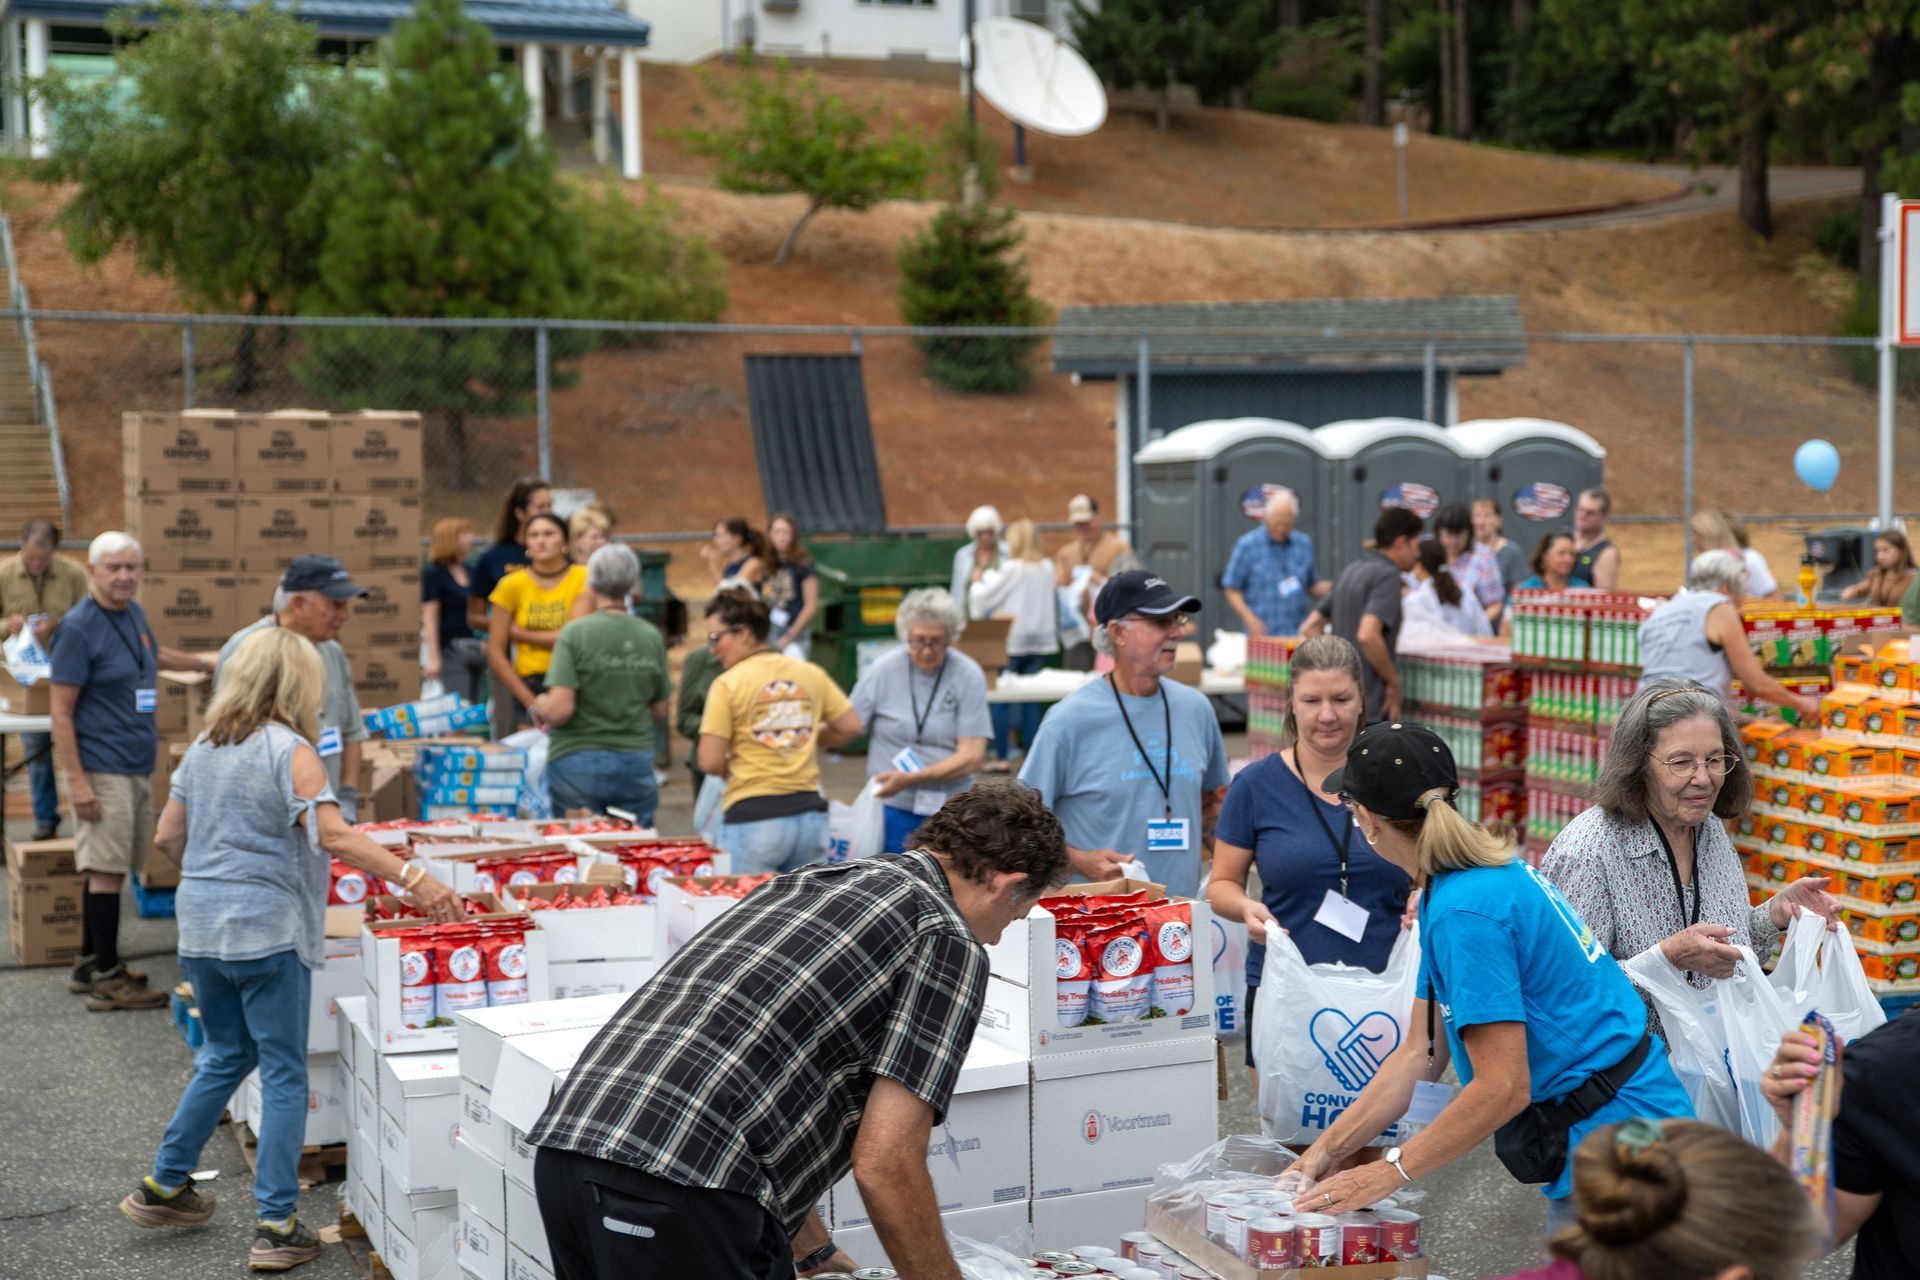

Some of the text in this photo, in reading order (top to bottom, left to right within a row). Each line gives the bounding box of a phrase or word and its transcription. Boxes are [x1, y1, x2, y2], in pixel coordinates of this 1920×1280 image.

[1161, 924, 1189, 944] VOORTMAN
[1105, 939, 1137, 960] VOORTMAN
[1154, 976, 1182, 986] Holiday
[1099, 988, 1129, 999] Holiday
[1216, 995, 1234, 1006] OF
[1304, 1092, 1357, 1108] CONV
[1106, 1113, 1172, 1132] Voortman
